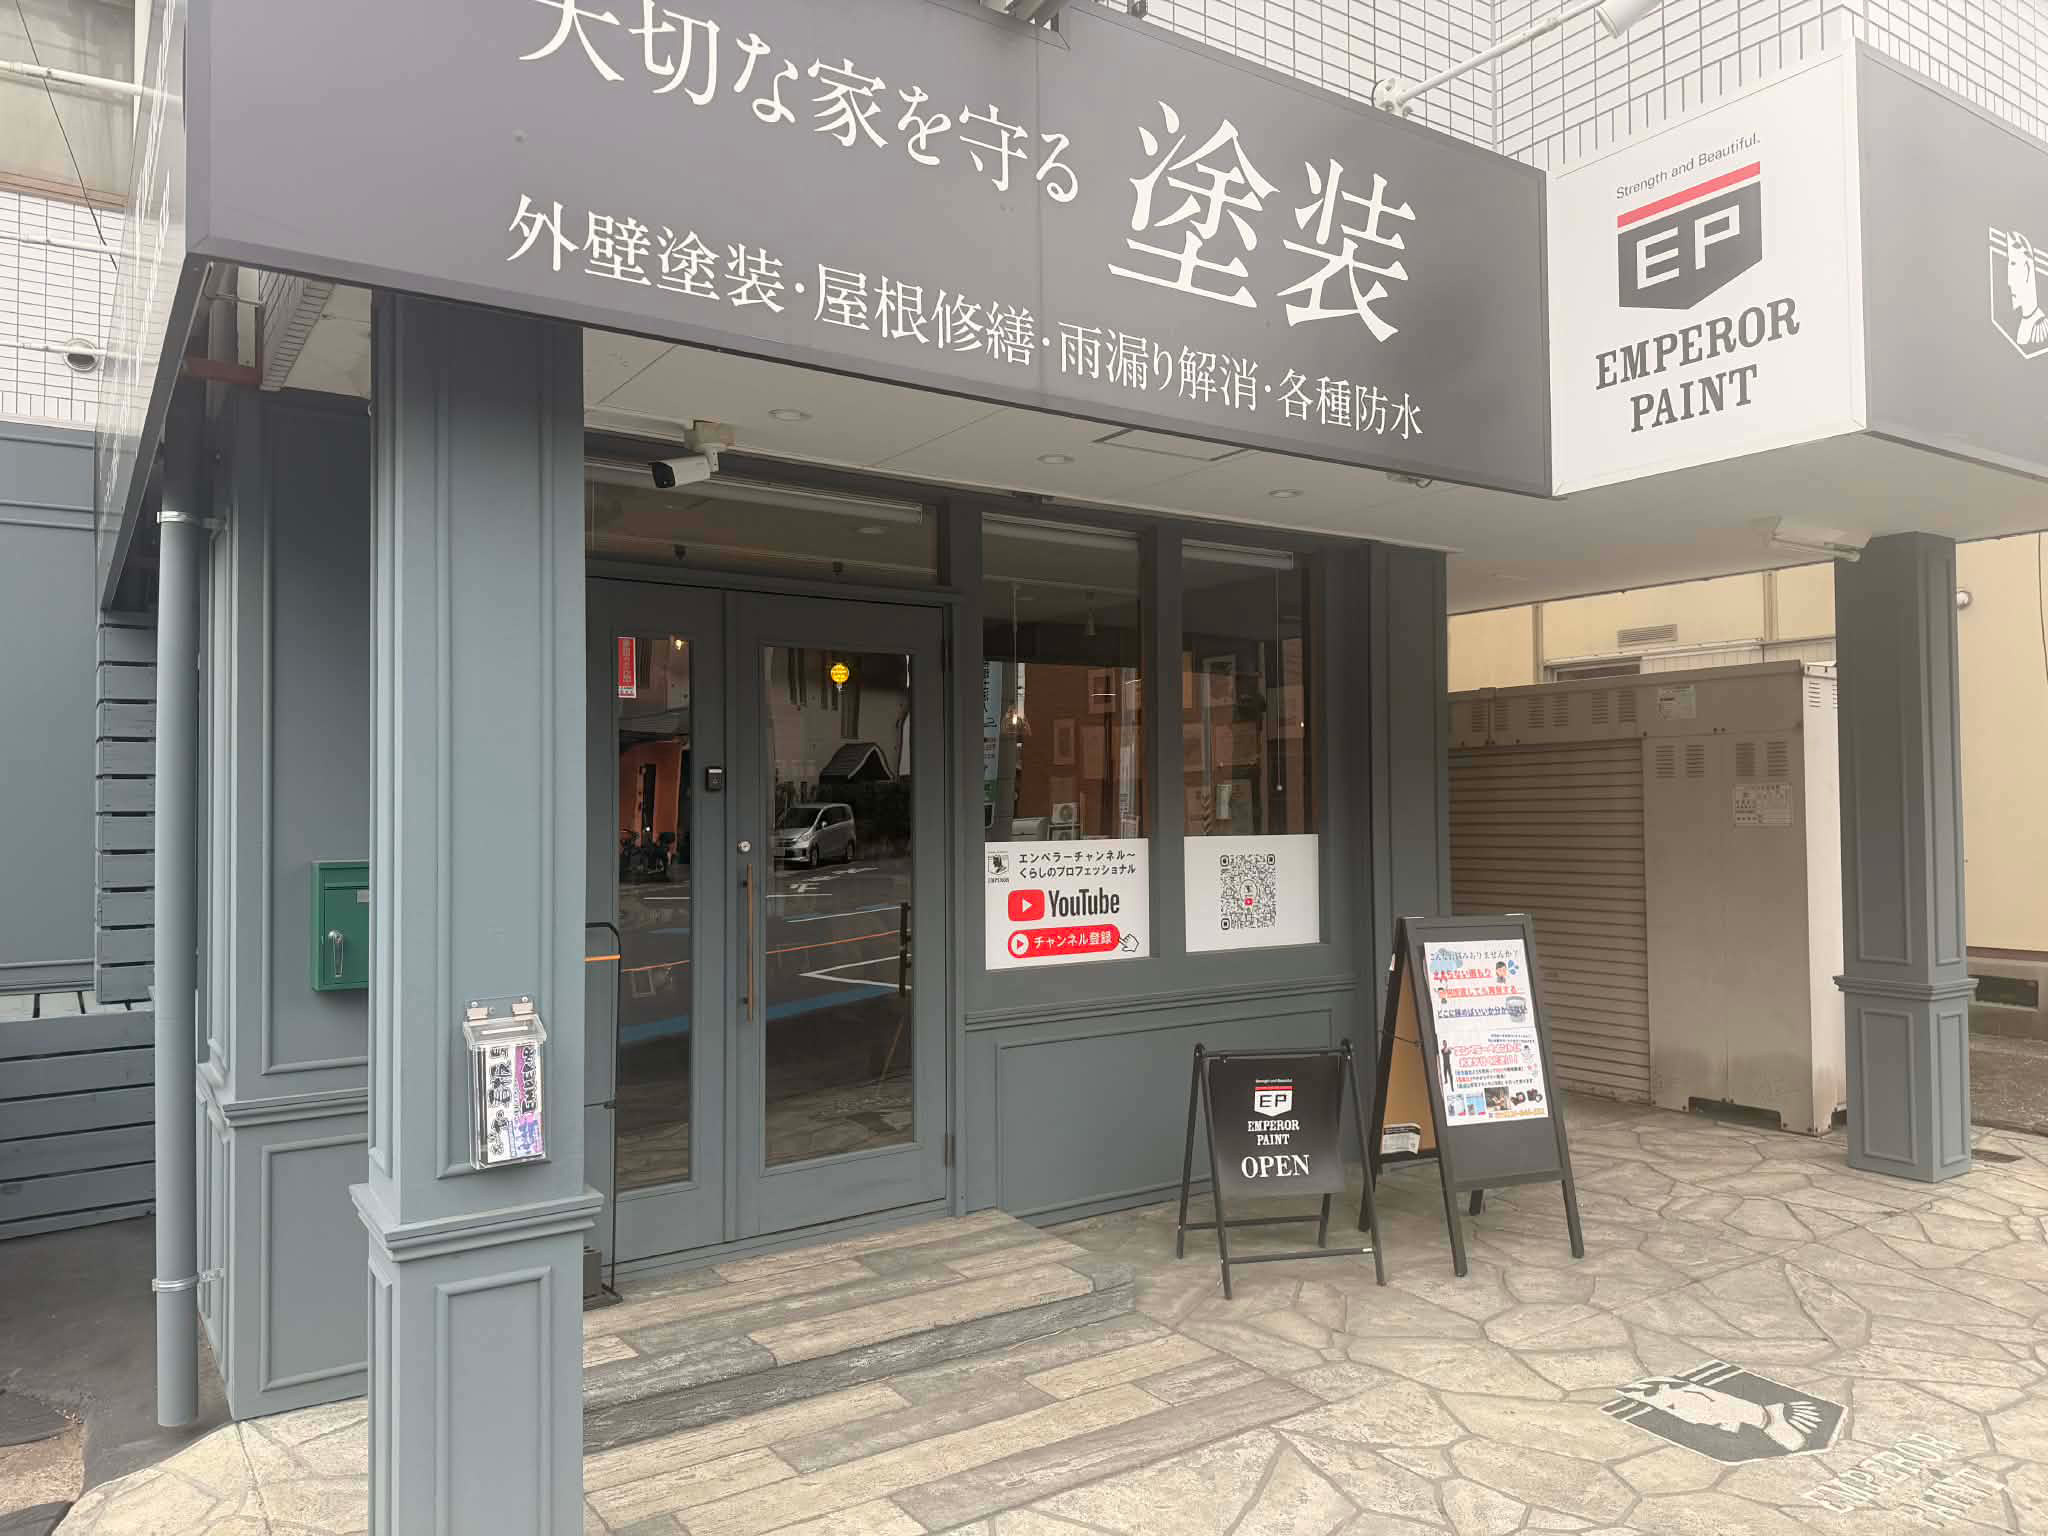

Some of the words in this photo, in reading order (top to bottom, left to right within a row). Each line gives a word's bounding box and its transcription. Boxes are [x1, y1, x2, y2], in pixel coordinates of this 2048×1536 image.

[519, 0, 1079, 204] 大切な家を守る
[1107, 100, 1417, 344] 塗装
[1616, 170, 1667, 199] Strength
[1671, 158, 1694, 178] and
[1699, 132, 1761, 166] Beautiful.
[1636, 204, 1740, 290] EP
[1595, 297, 1800, 390] EMPEROR
[1630, 364, 1758, 432] PAINT
[1019, 864, 1136, 879] くらしのプロフェッショナル
[1048, 887, 1120, 918] YouTube
[1034, 930, 1113, 949] チャンネル登録
[1260, 1094, 1287, 1108] EP
[1247, 1119, 1300, 1132] EMPEROR
[1257, 1133, 1290, 1146] PAINT
[1241, 1154, 1310, 1179] OPEN
